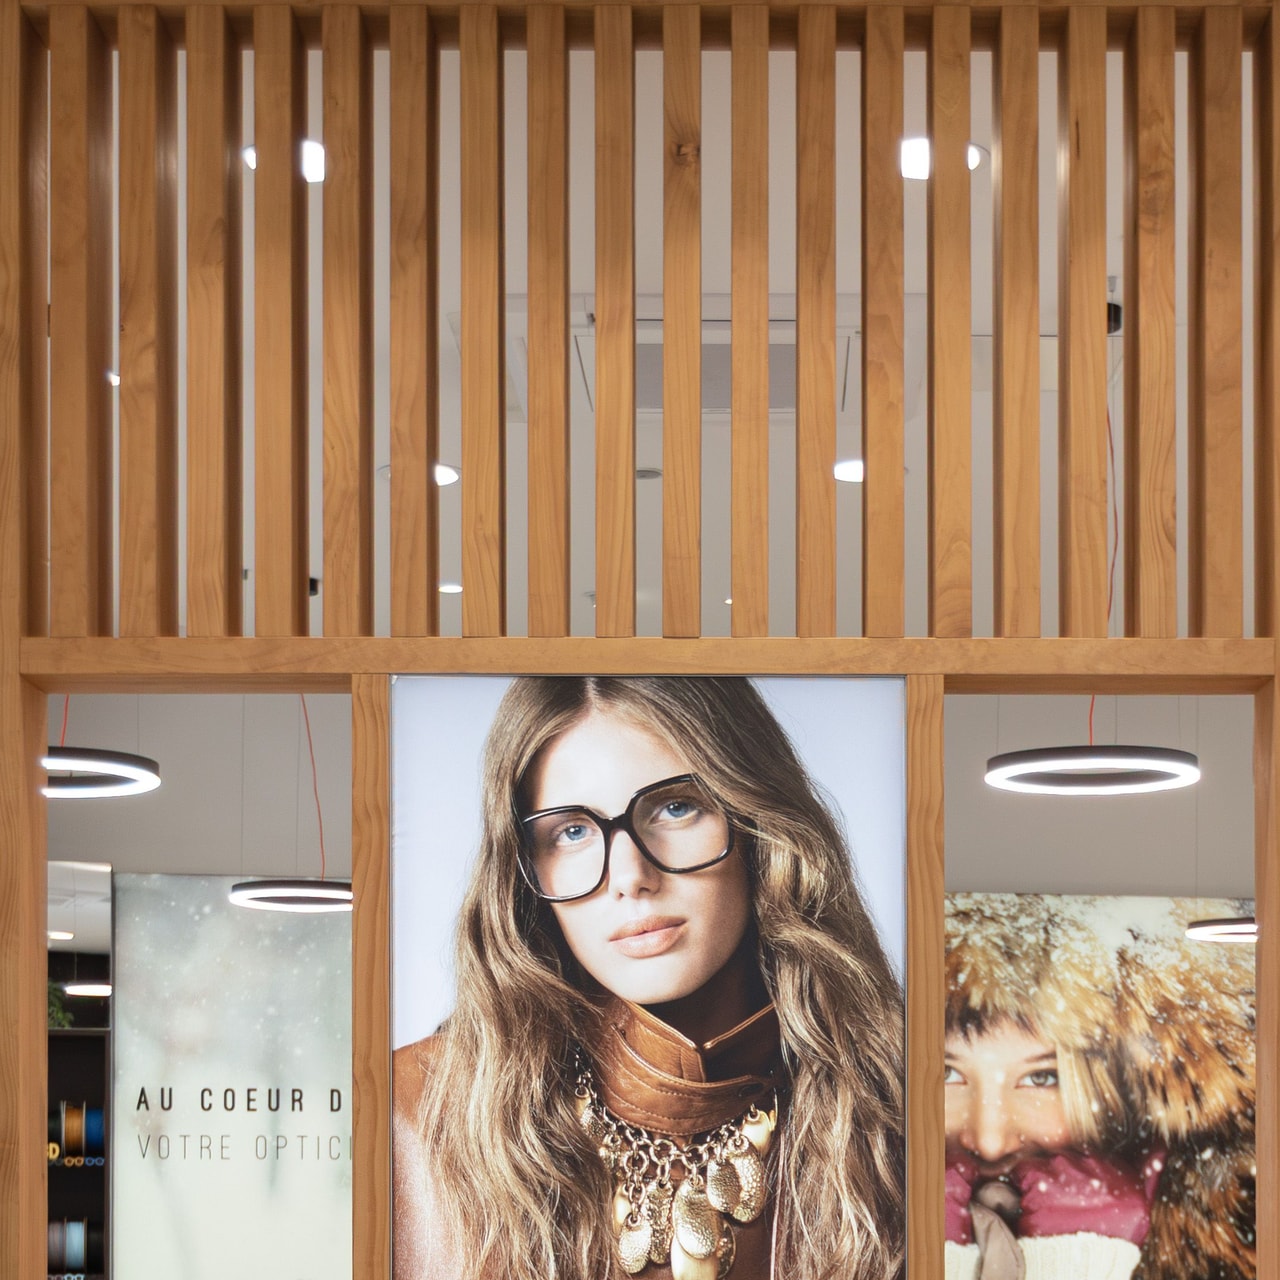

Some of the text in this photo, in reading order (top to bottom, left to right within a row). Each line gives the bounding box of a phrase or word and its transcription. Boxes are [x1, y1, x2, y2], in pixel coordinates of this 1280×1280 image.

[136, 1086, 173, 1112] AU
[200, 1087, 303, 1112] COEUR
[137, 1134, 231, 1160] VOTRE
